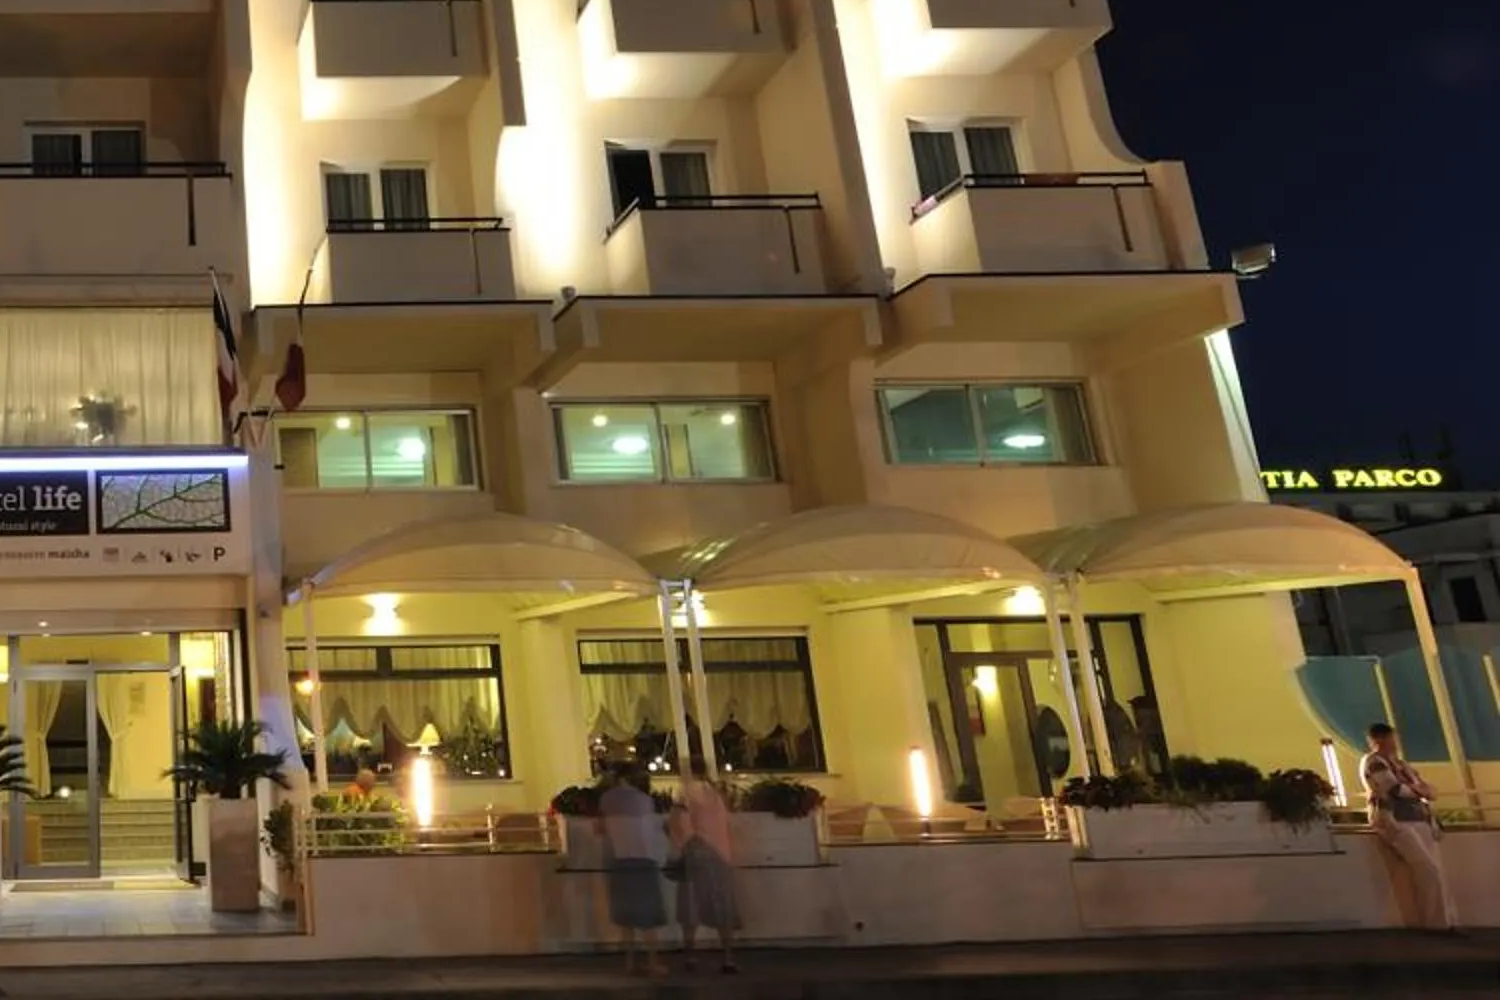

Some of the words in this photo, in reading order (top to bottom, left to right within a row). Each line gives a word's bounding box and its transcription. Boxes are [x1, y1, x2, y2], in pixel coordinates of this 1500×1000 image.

[1332, 468, 1442, 488] PARCO
[32, 485, 82, 511] life
[30, 519, 57, 534] style
[213, 547, 226, 561] P
